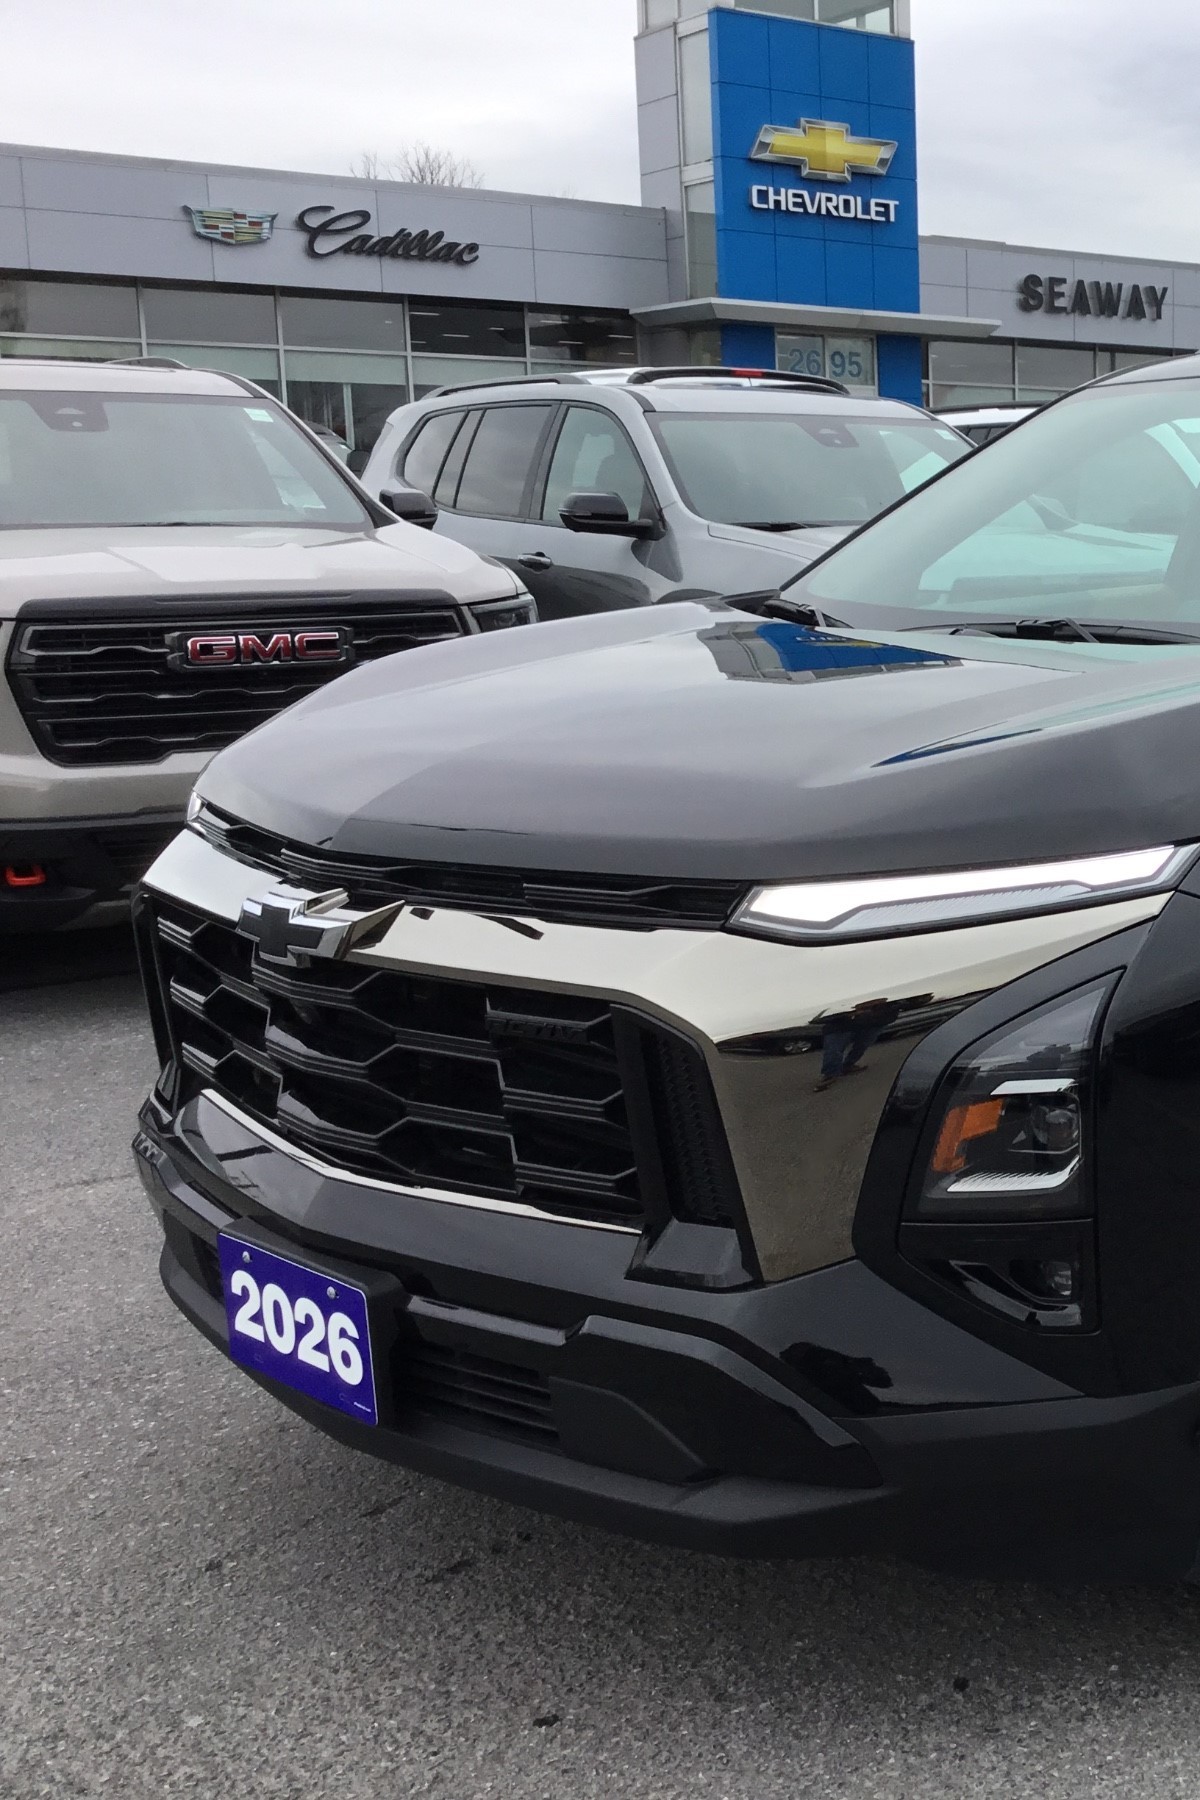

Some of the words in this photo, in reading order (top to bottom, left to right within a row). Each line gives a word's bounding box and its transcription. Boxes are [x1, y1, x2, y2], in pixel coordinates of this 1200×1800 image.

[751, 184, 900, 222] CHEVROLET
[296, 205, 480, 265] Cadillac
[1018, 273, 1168, 321] SEAWAY
[186, 631, 341, 664] GMC
[230, 1269, 364, 1386] 2026
